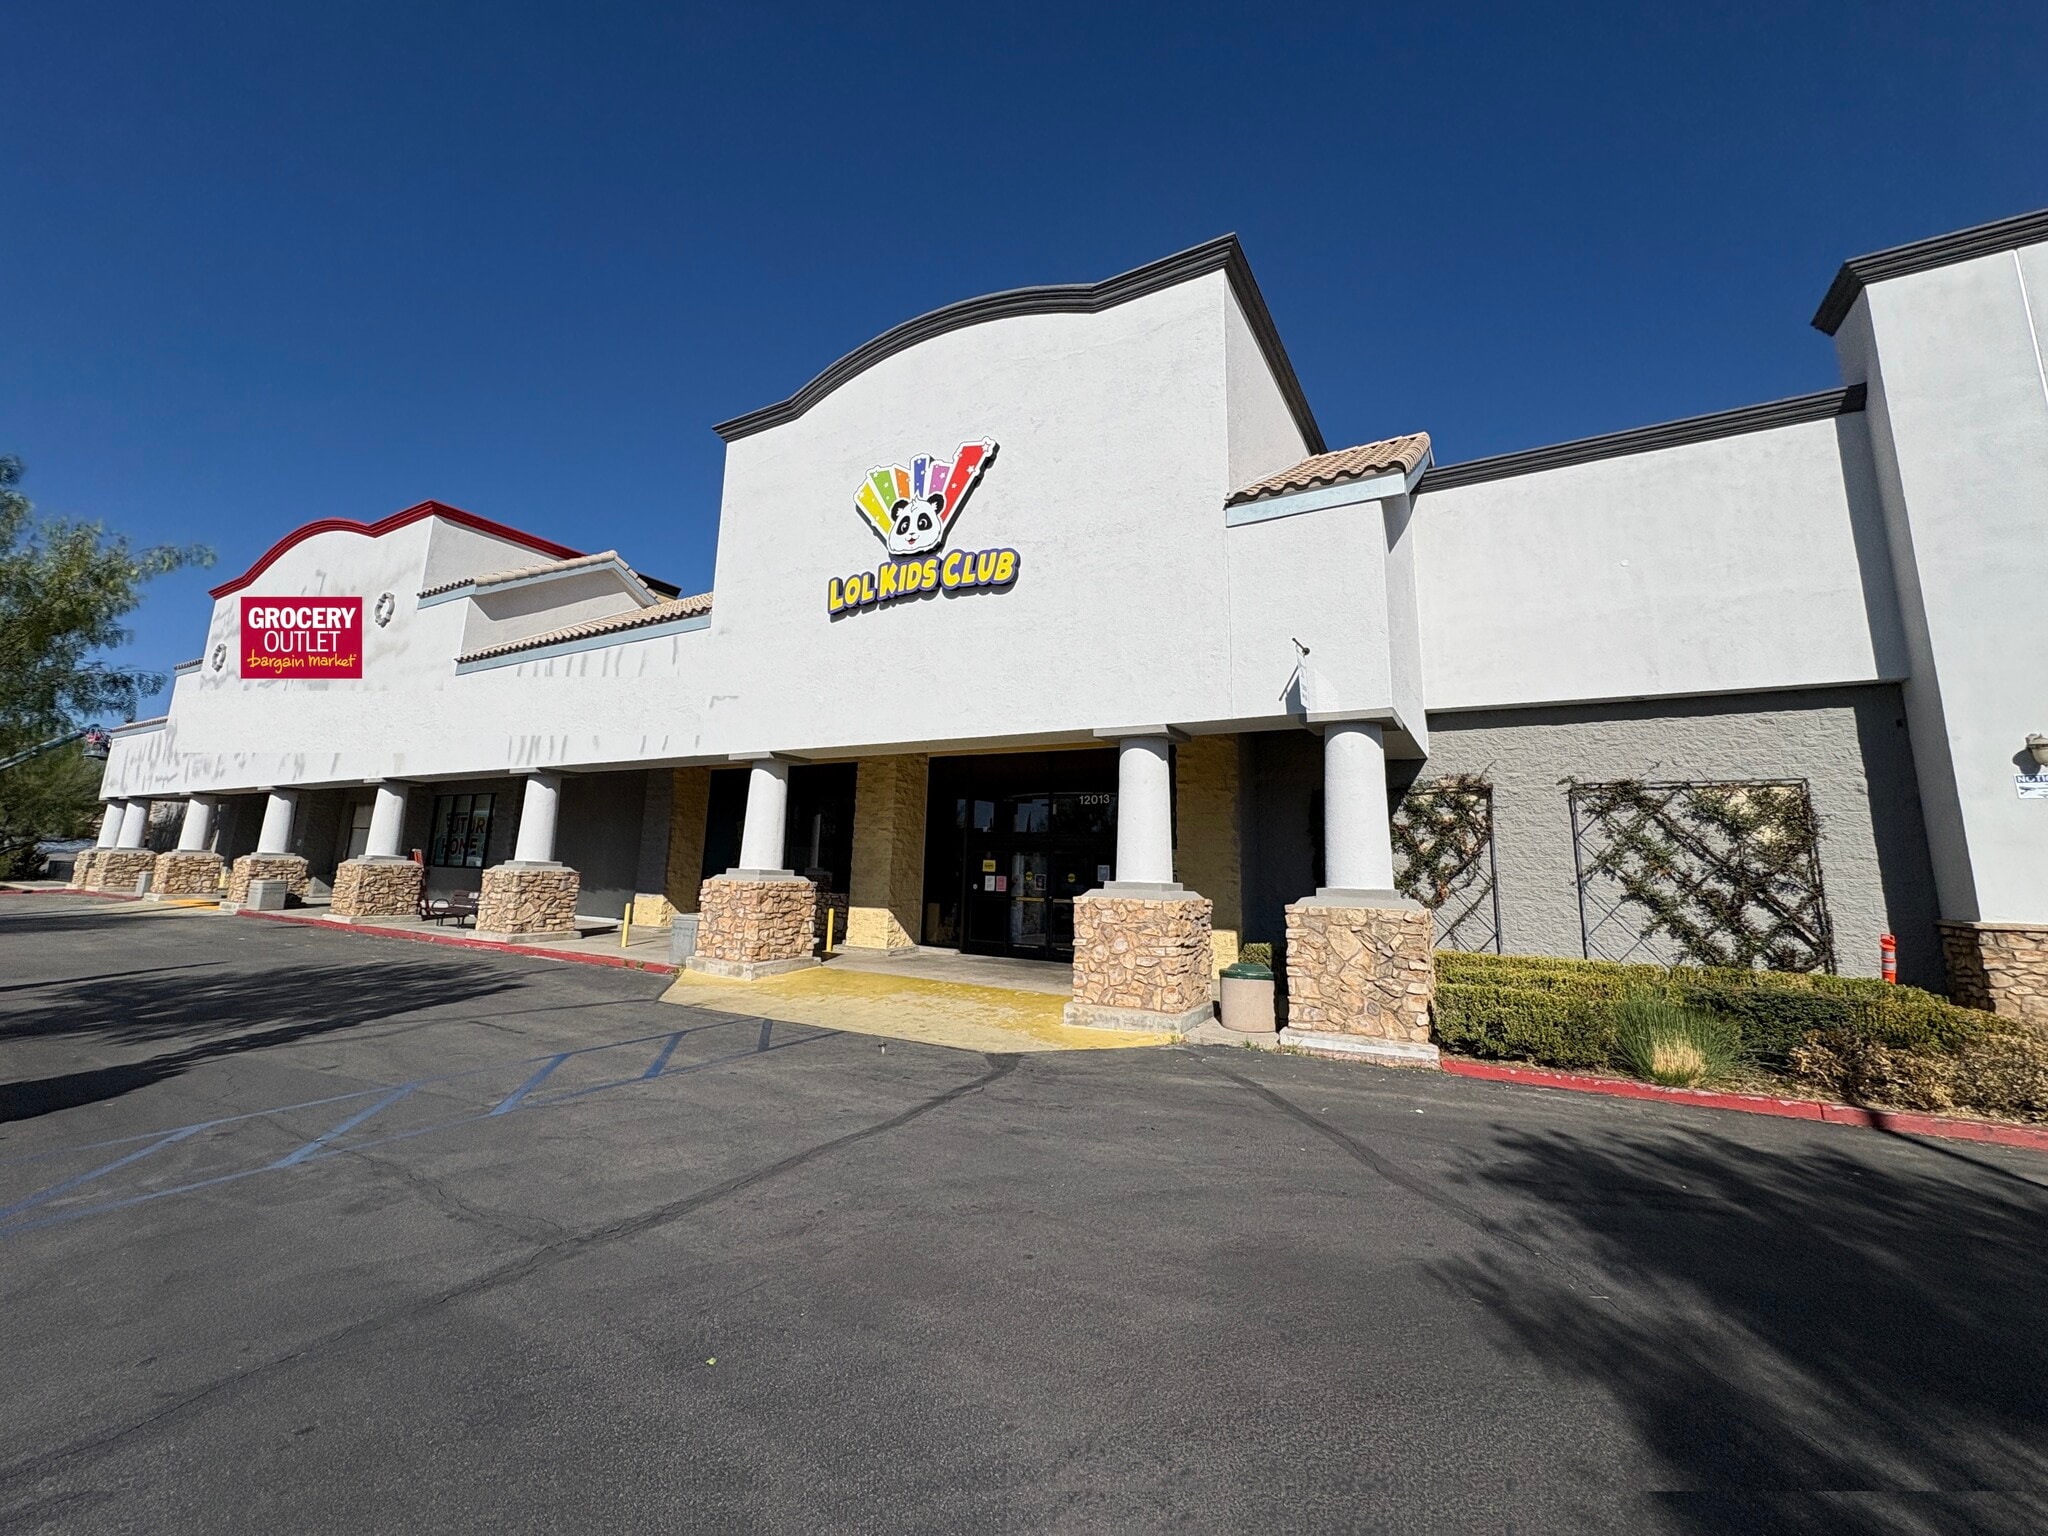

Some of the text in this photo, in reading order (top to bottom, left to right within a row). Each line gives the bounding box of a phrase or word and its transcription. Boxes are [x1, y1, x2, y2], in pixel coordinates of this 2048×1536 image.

[828, 551, 1016, 612] LOL KIDS CLUB
[248, 607, 356, 629] GROCERY
[264, 630, 341, 652] OUTLET
[247, 649, 357, 674] bargain market
[1079, 794, 1110, 805] 12013
[446, 815, 494, 835] FUTUR
